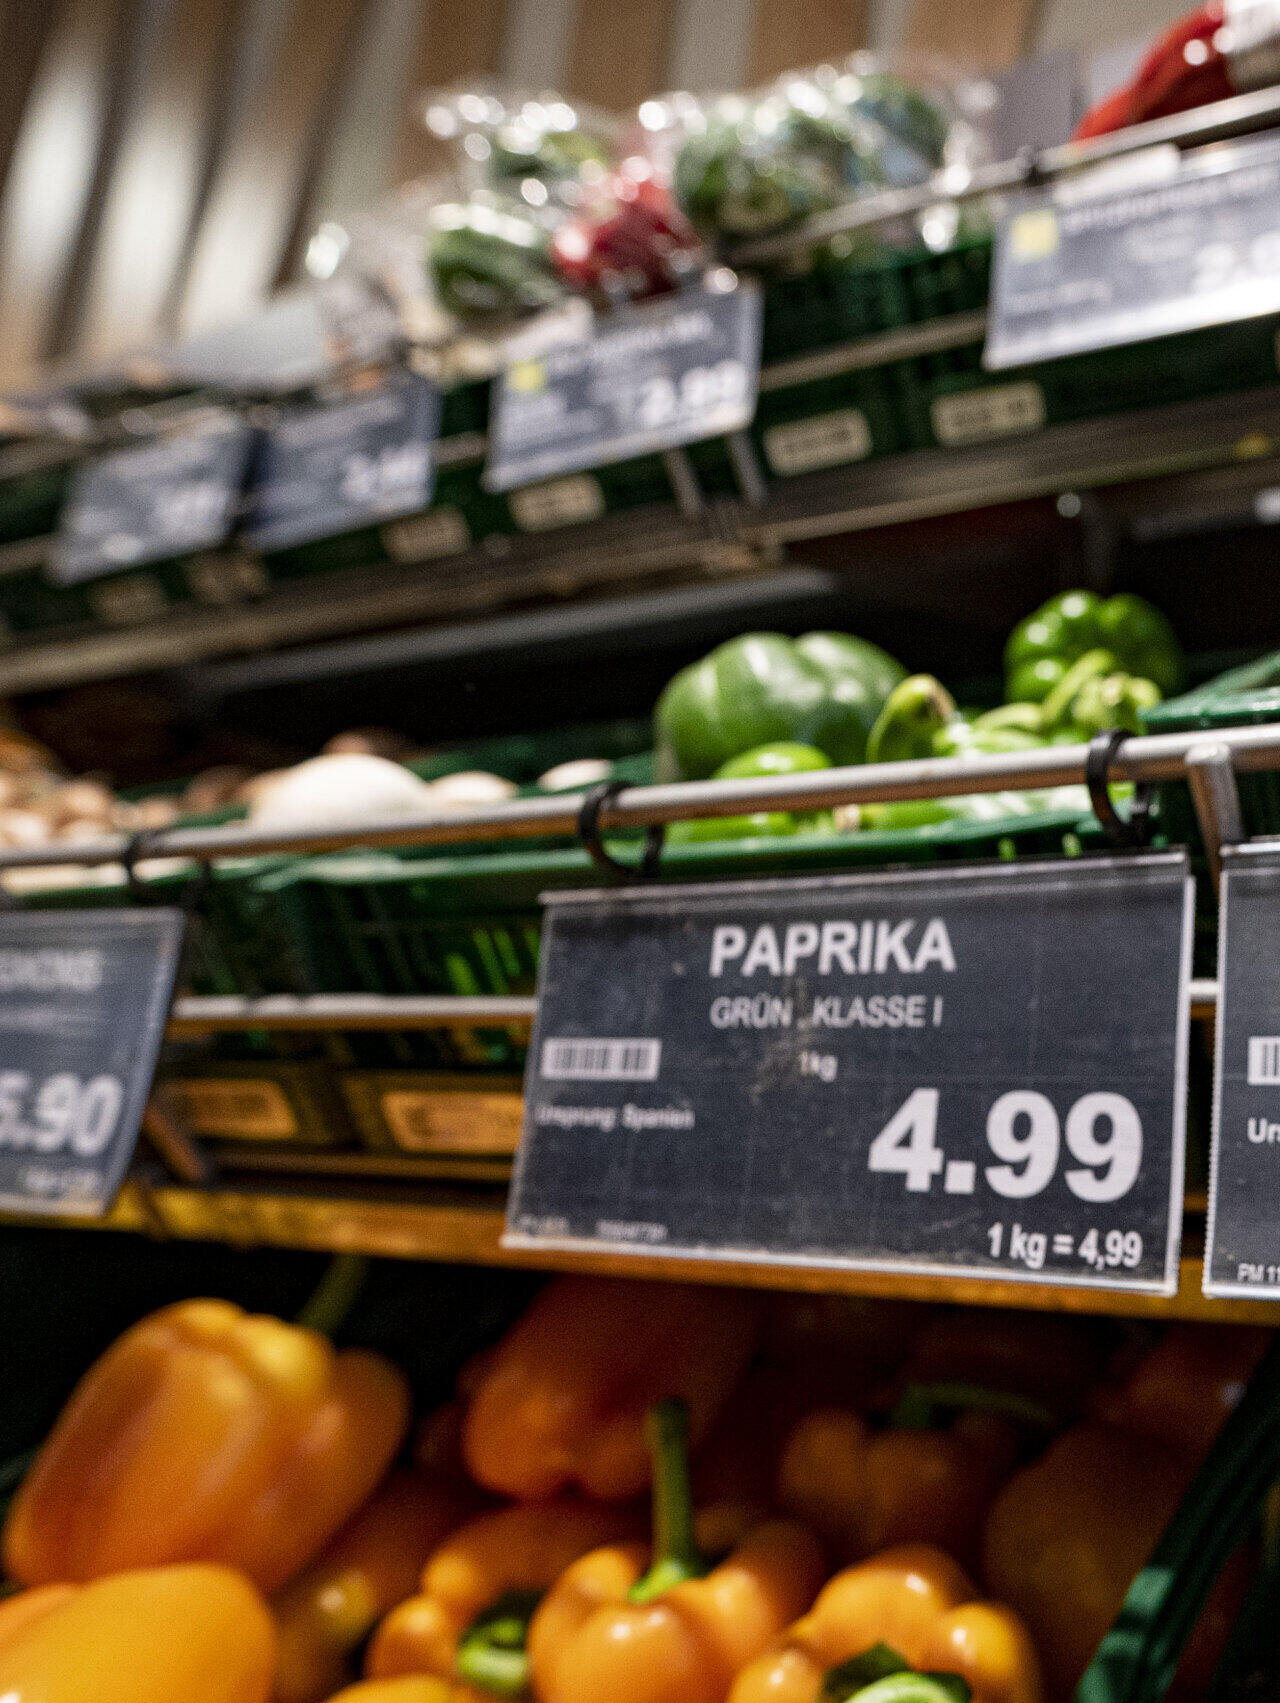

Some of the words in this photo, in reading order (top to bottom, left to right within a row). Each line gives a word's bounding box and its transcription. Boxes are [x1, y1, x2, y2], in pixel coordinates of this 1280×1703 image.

[709, 918, 957, 977] PAPRIKA
[812, 995, 926, 1028] KLASSE
[932, 996, 944, 1026] I
[868, 1088, 1143, 1203] 4.99
[987, 1222, 1003, 1258] 1
[1010, 1223, 1047, 1269] kg
[1078, 1228, 1143, 1271] 4,99
